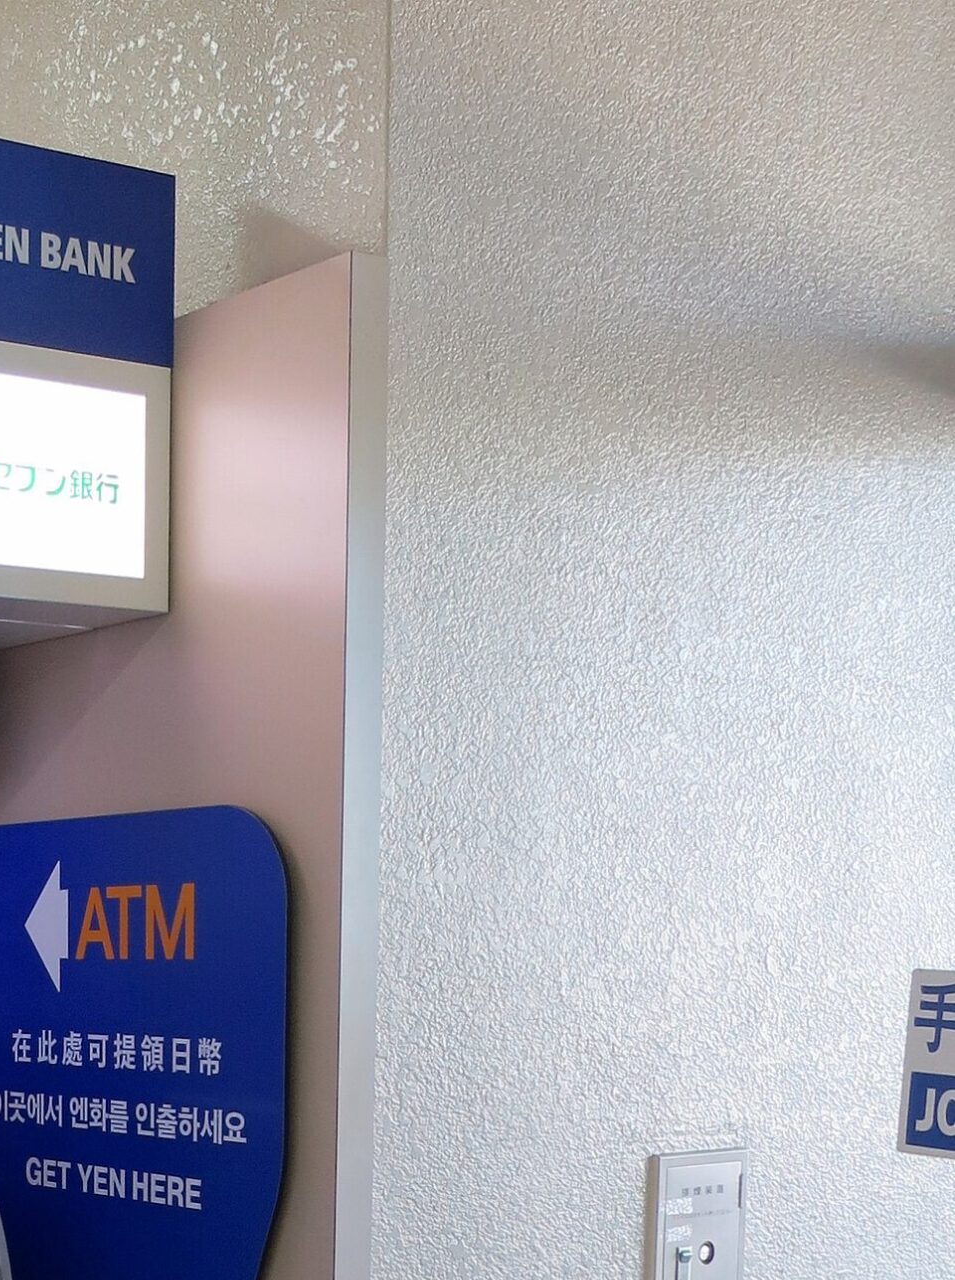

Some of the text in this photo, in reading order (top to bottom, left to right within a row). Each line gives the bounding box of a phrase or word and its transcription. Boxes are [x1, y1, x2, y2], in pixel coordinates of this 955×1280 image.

[40, 231, 136, 285] BANK
[75, 882, 195, 960] ATM
[11, 1028, 222, 1076] 在此處可提領日幣
[69, 1096, 129, 1134] 엔화를
[135, 1102, 247, 1145] 인출하세요
[25, 1156, 202, 1210] GET YEN HERE
